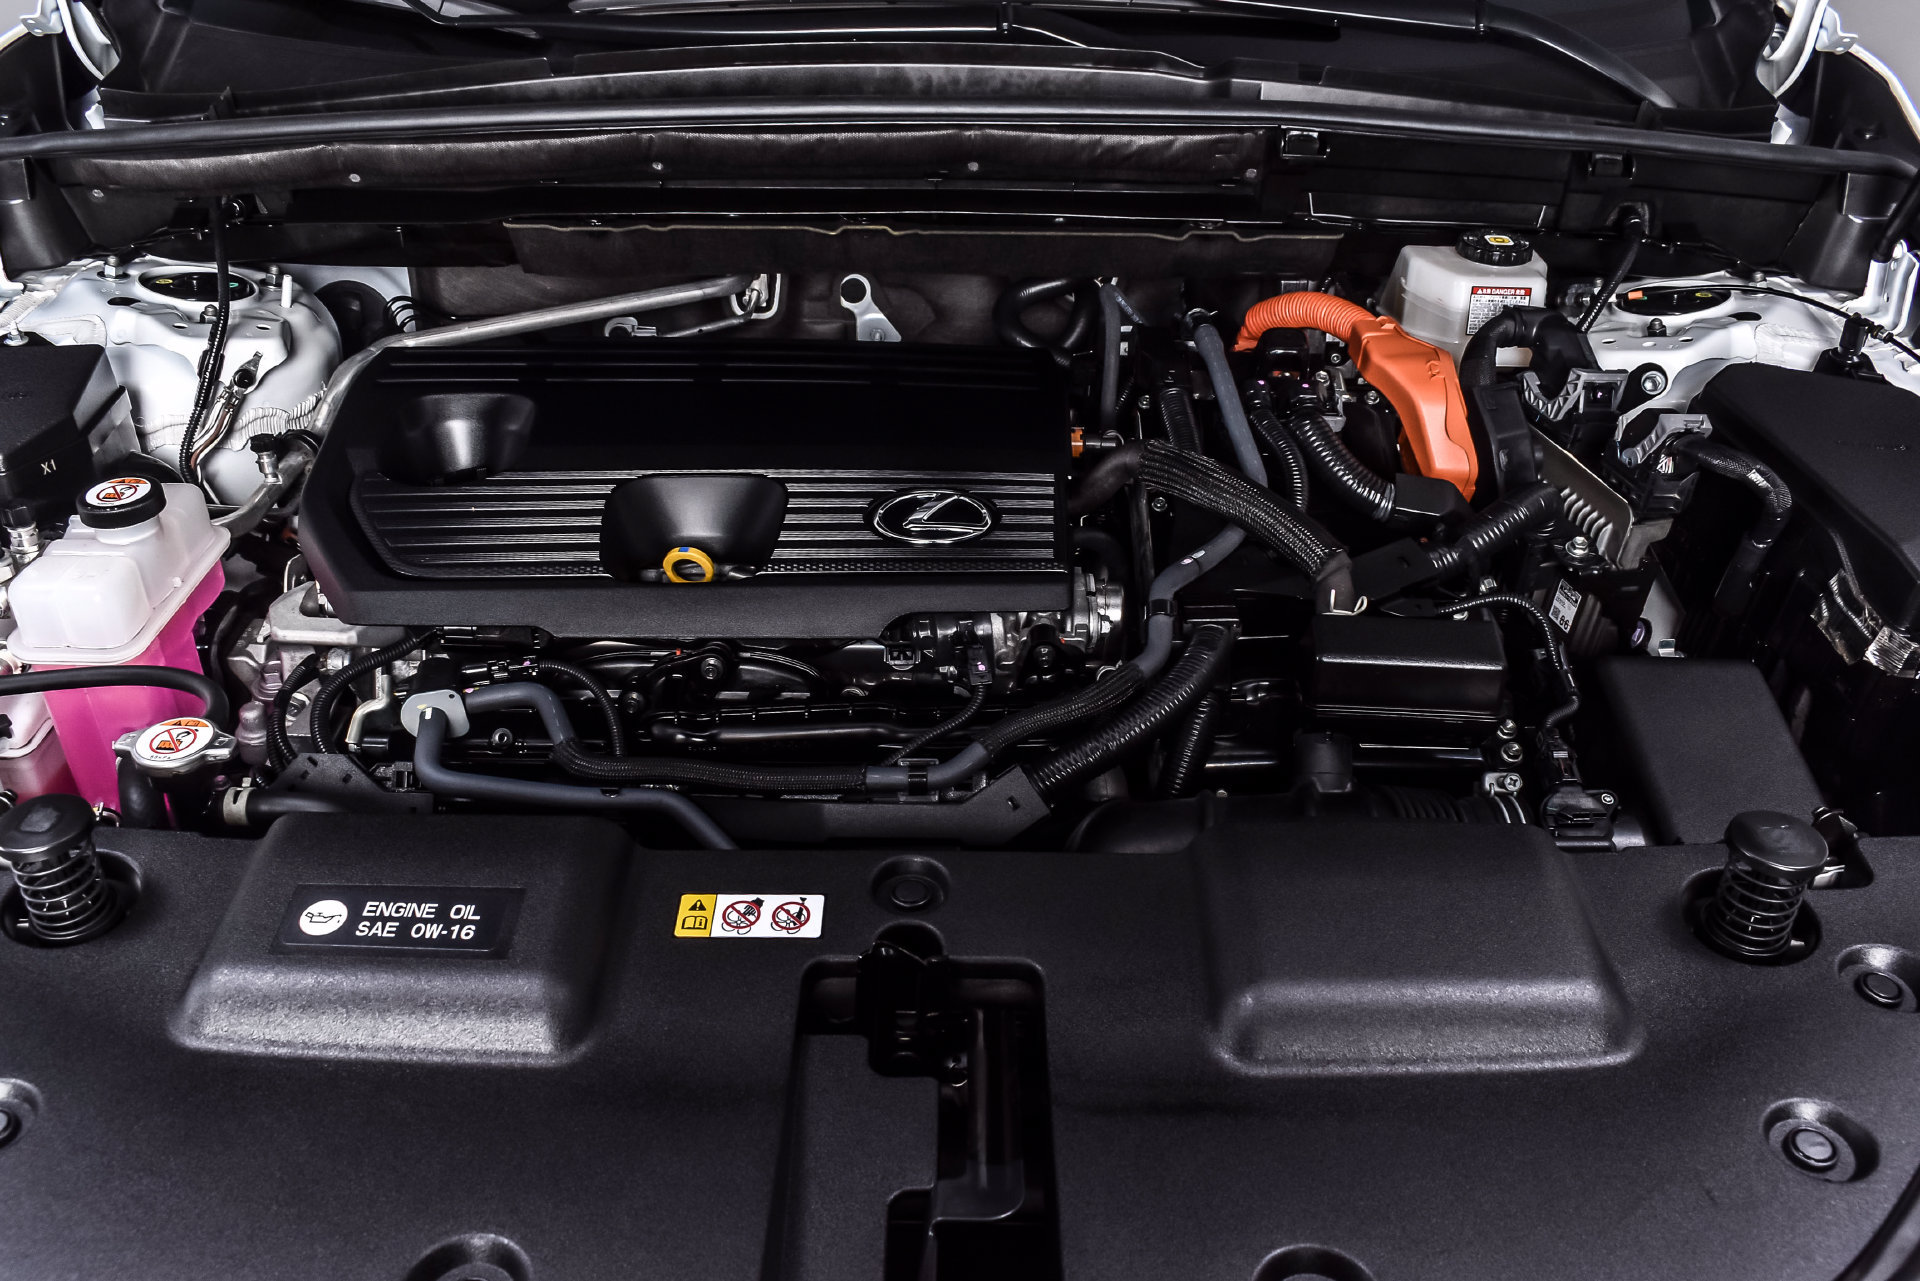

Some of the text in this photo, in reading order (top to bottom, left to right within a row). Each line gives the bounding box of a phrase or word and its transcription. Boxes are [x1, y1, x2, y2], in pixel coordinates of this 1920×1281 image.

[40, 459, 57, 475] X1
[362, 901, 480, 920] ENGINE OIL
[355, 921, 399, 937] SAE
